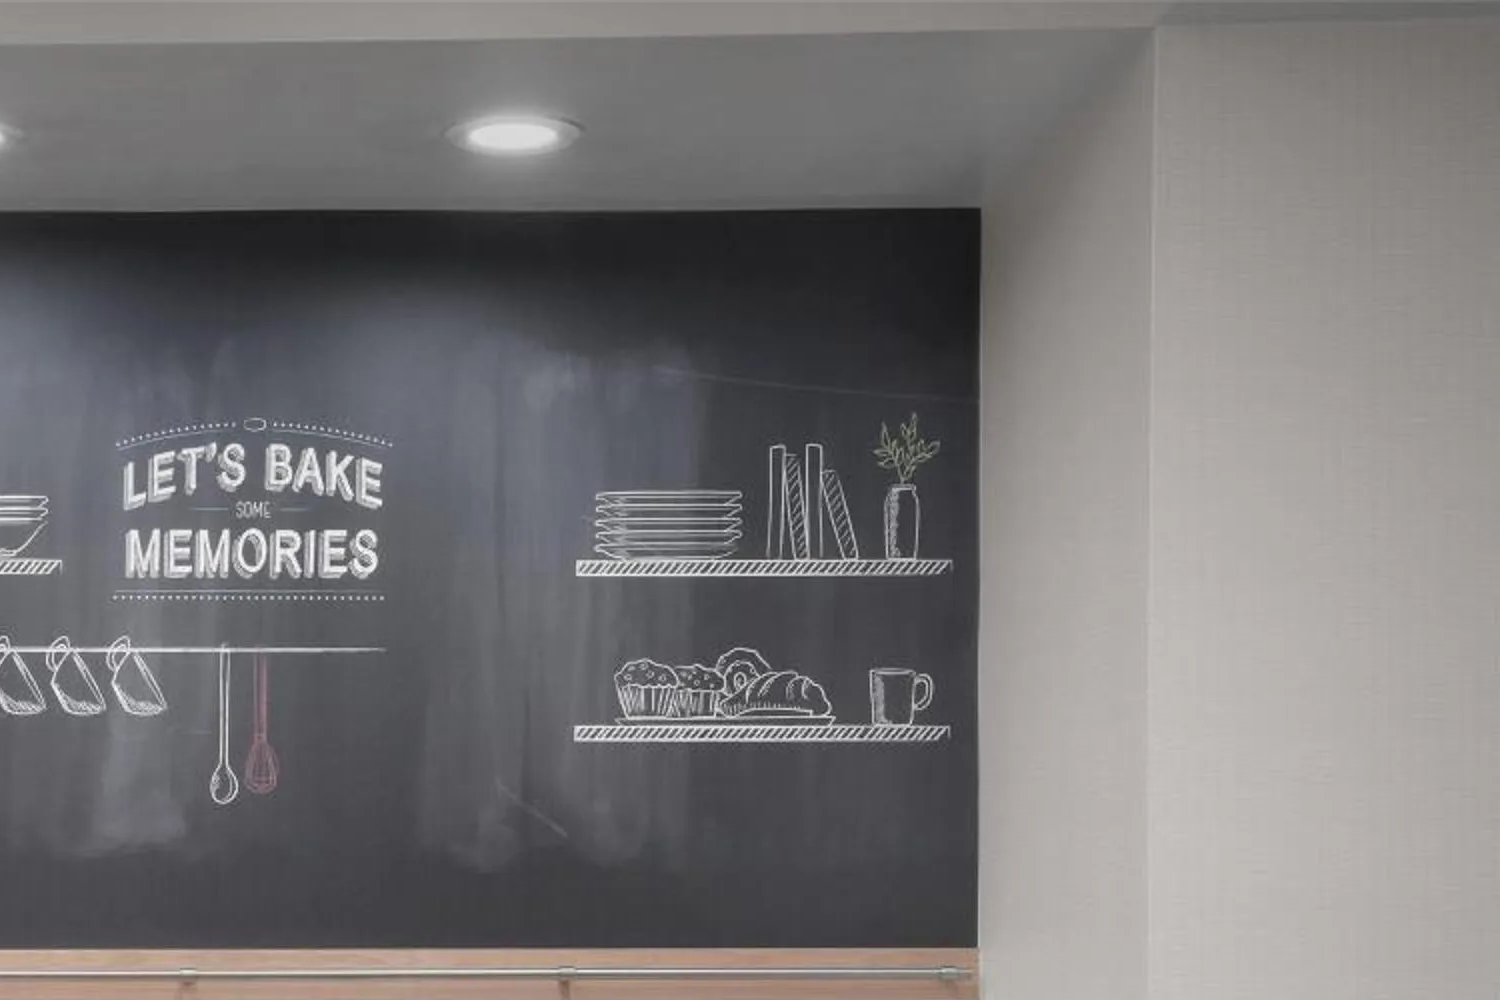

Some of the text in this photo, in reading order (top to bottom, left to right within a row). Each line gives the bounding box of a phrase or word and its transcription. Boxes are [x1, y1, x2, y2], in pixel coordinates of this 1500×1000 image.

[123, 442, 383, 511] LET'S BAKE
[236, 501, 271, 519] SOME
[125, 527, 378, 580] MEMORIES
